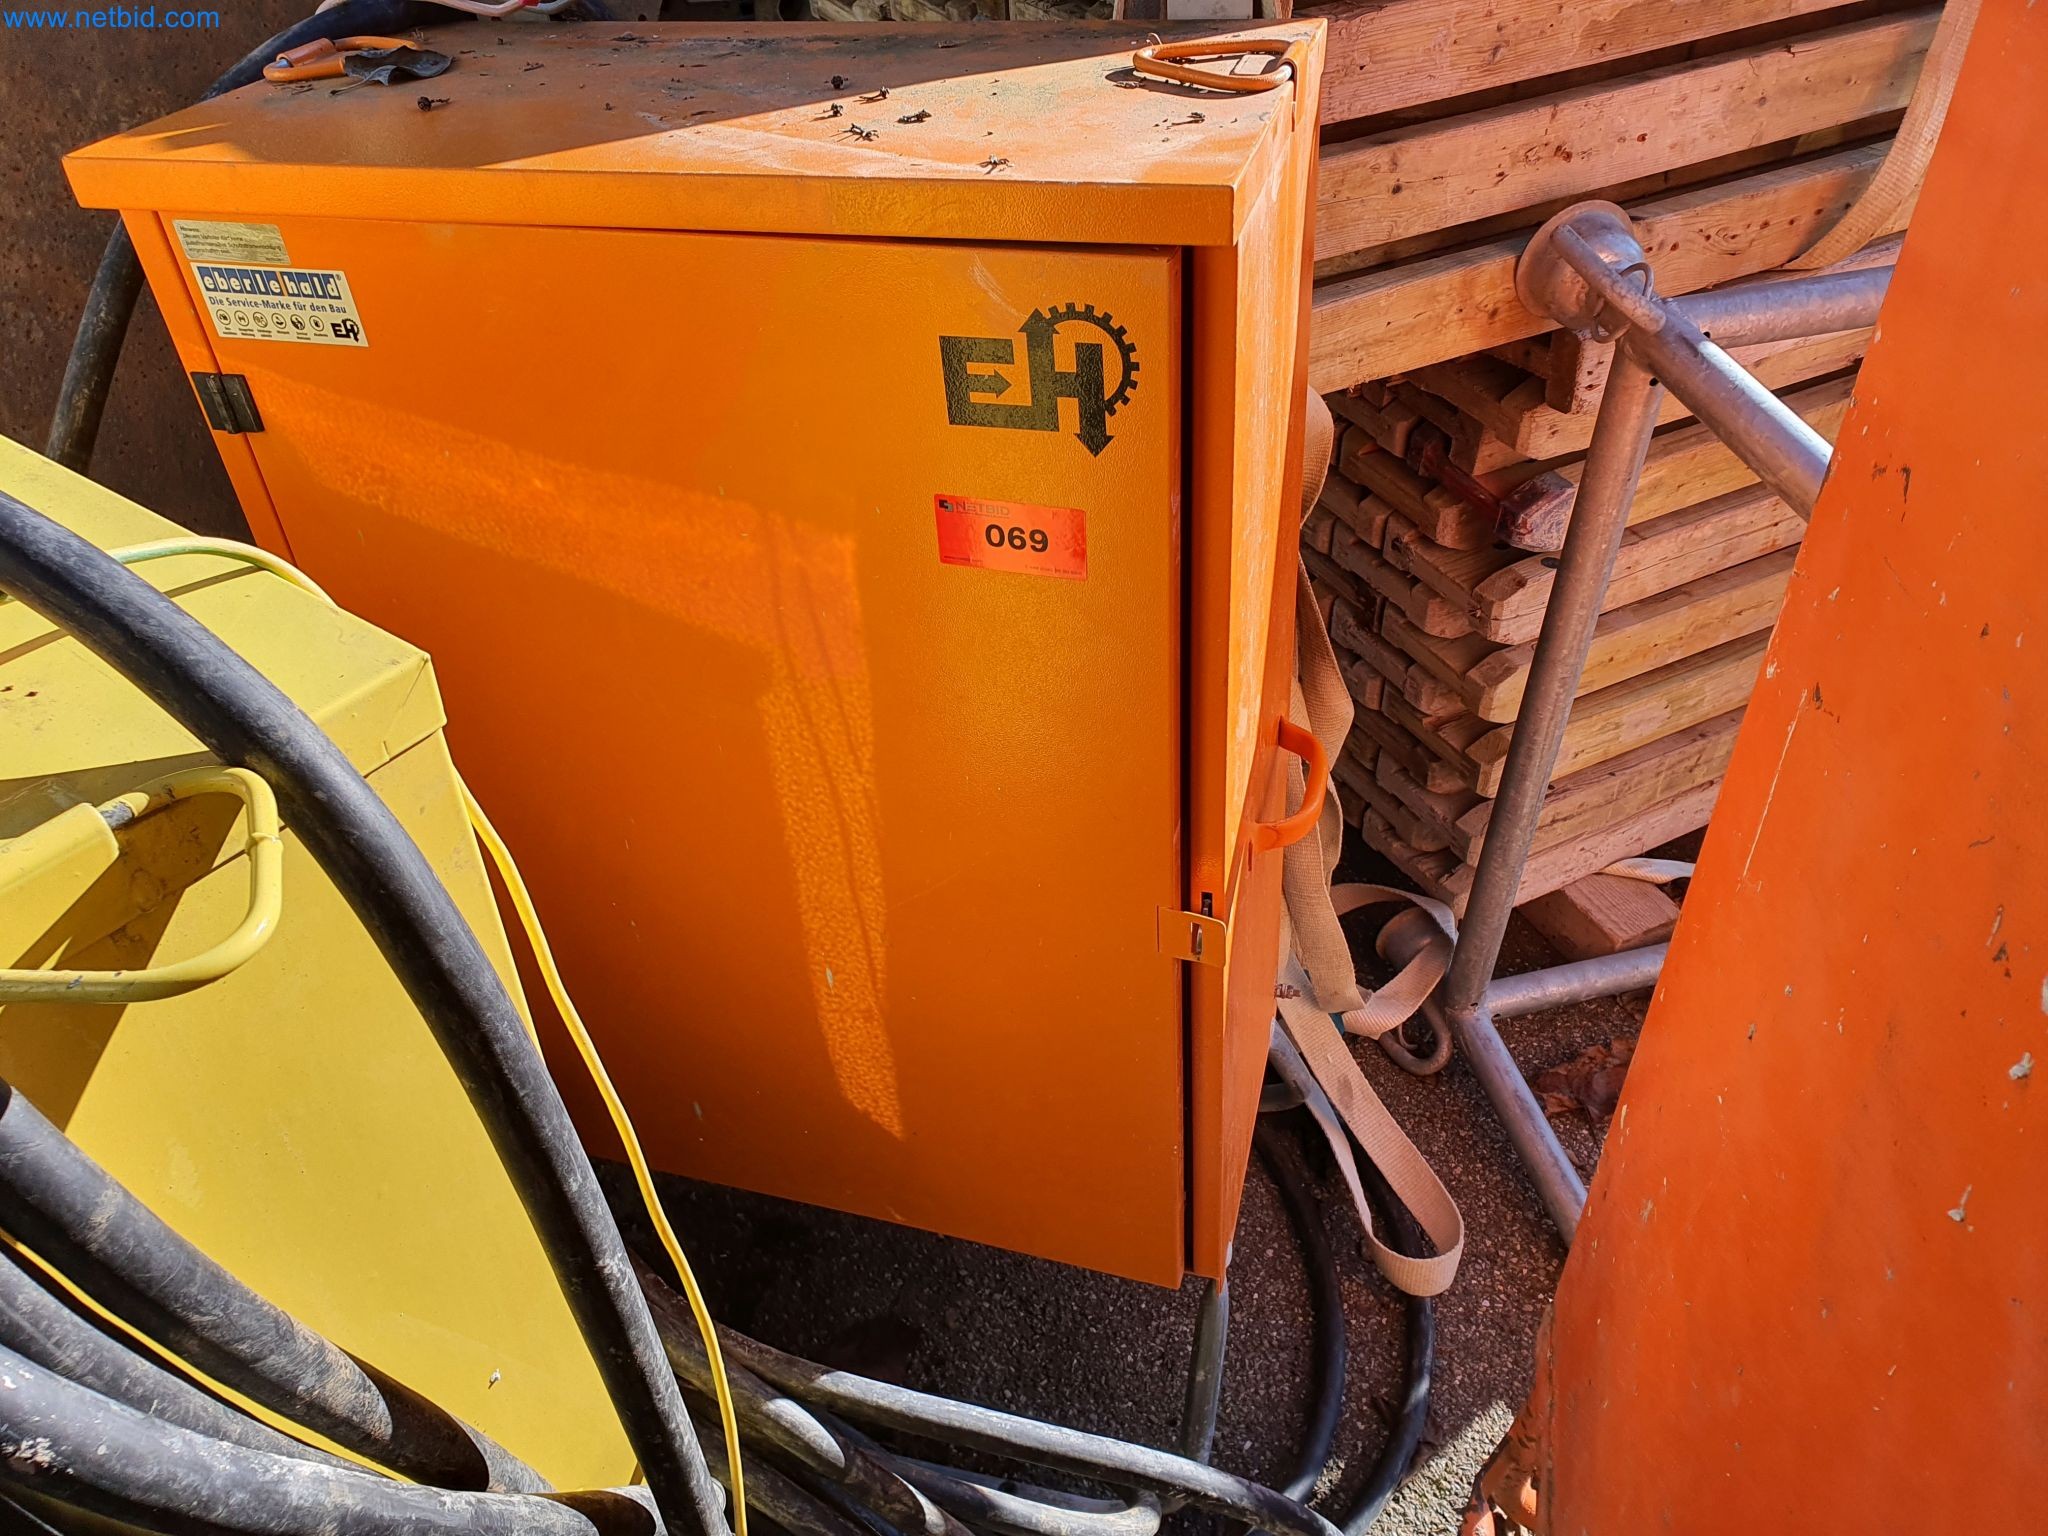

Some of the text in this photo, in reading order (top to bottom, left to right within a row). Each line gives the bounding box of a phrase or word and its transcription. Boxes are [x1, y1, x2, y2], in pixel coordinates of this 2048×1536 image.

[208, 296, 347, 314] Die Service-Marke für den Bau
[955, 502, 1010, 516] NETBID
[985, 524, 1049, 553] 069
